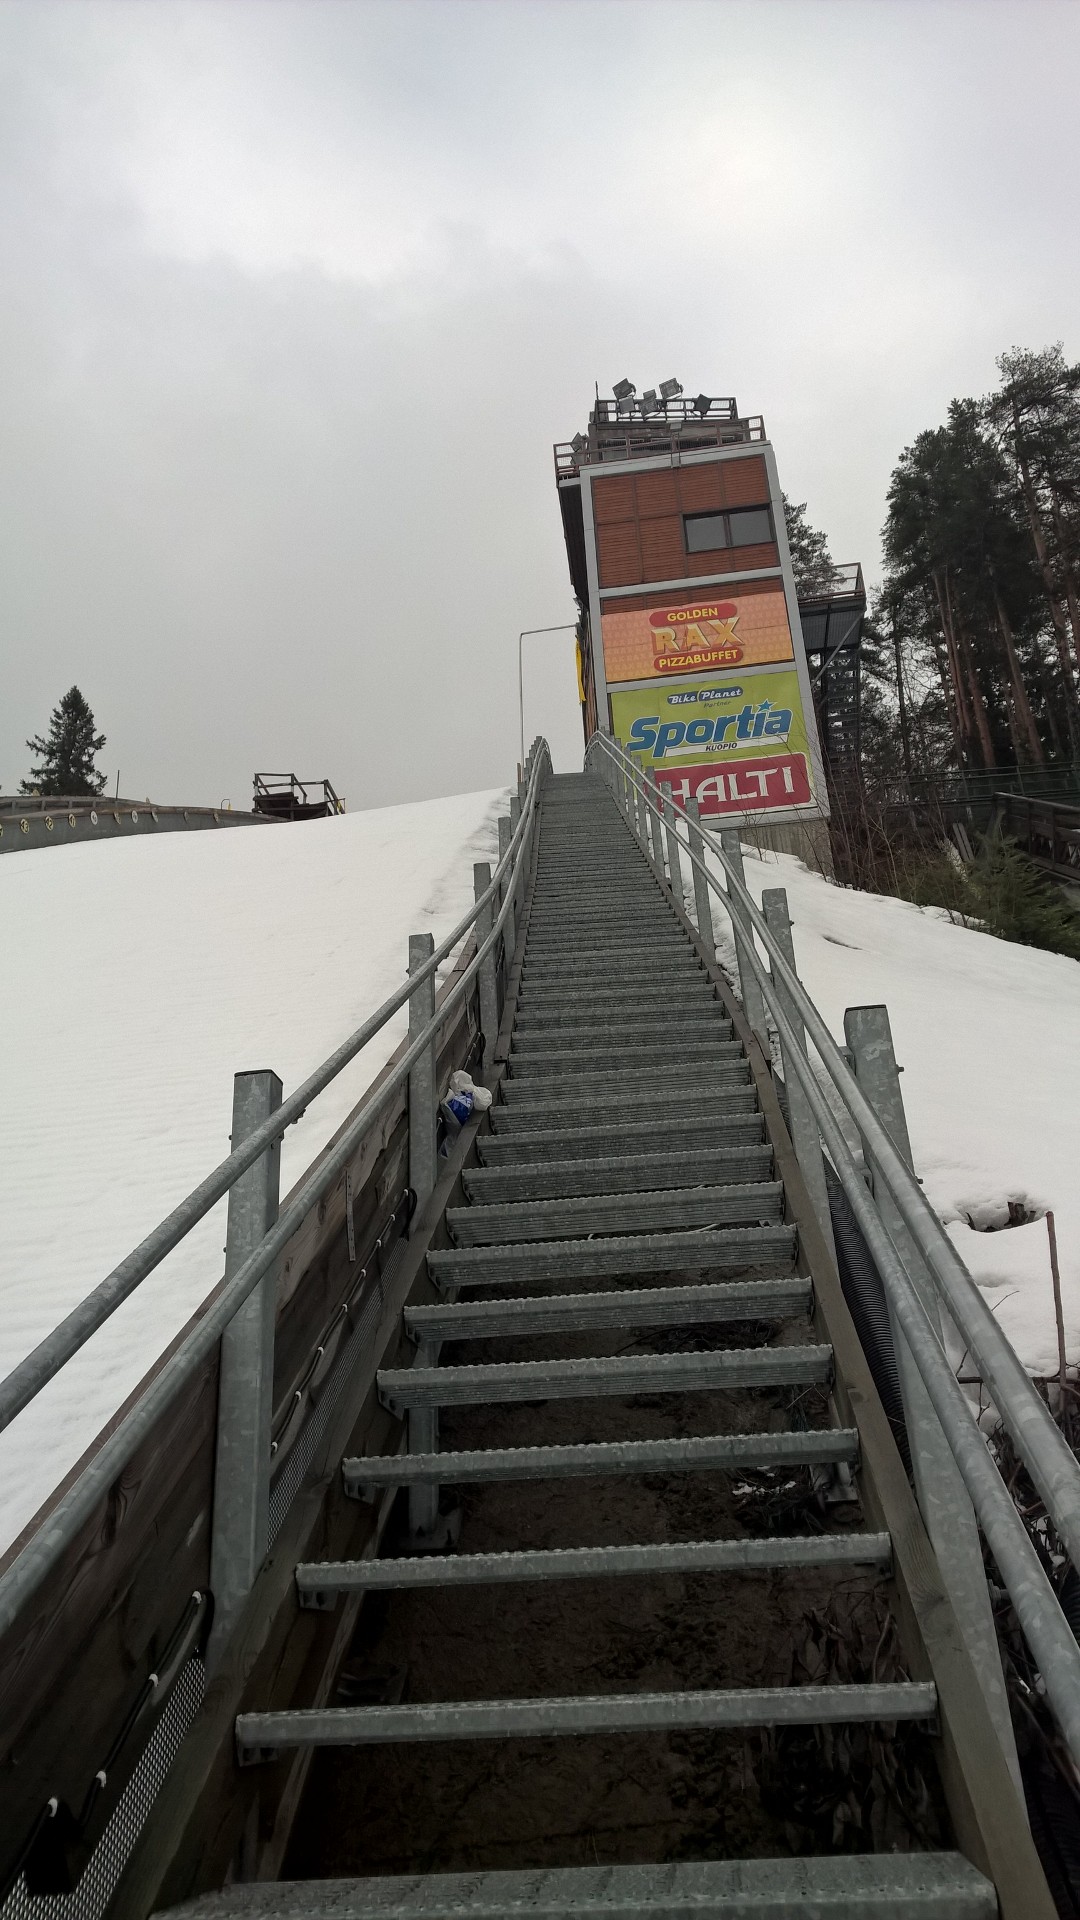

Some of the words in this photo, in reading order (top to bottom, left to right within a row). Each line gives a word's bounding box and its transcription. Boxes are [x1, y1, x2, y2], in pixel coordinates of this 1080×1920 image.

[667, 608, 718, 622] GOLDEN
[651, 616, 745, 655] RAX
[658, 650, 739, 668] PIZZABUFFET
[668, 692, 697, 704] Bike
[701, 688, 742, 700] Planet
[626, 699, 793, 758] Sportia
[705, 742, 738, 752] KUOPIO
[659, 767, 795, 805] HALTI
